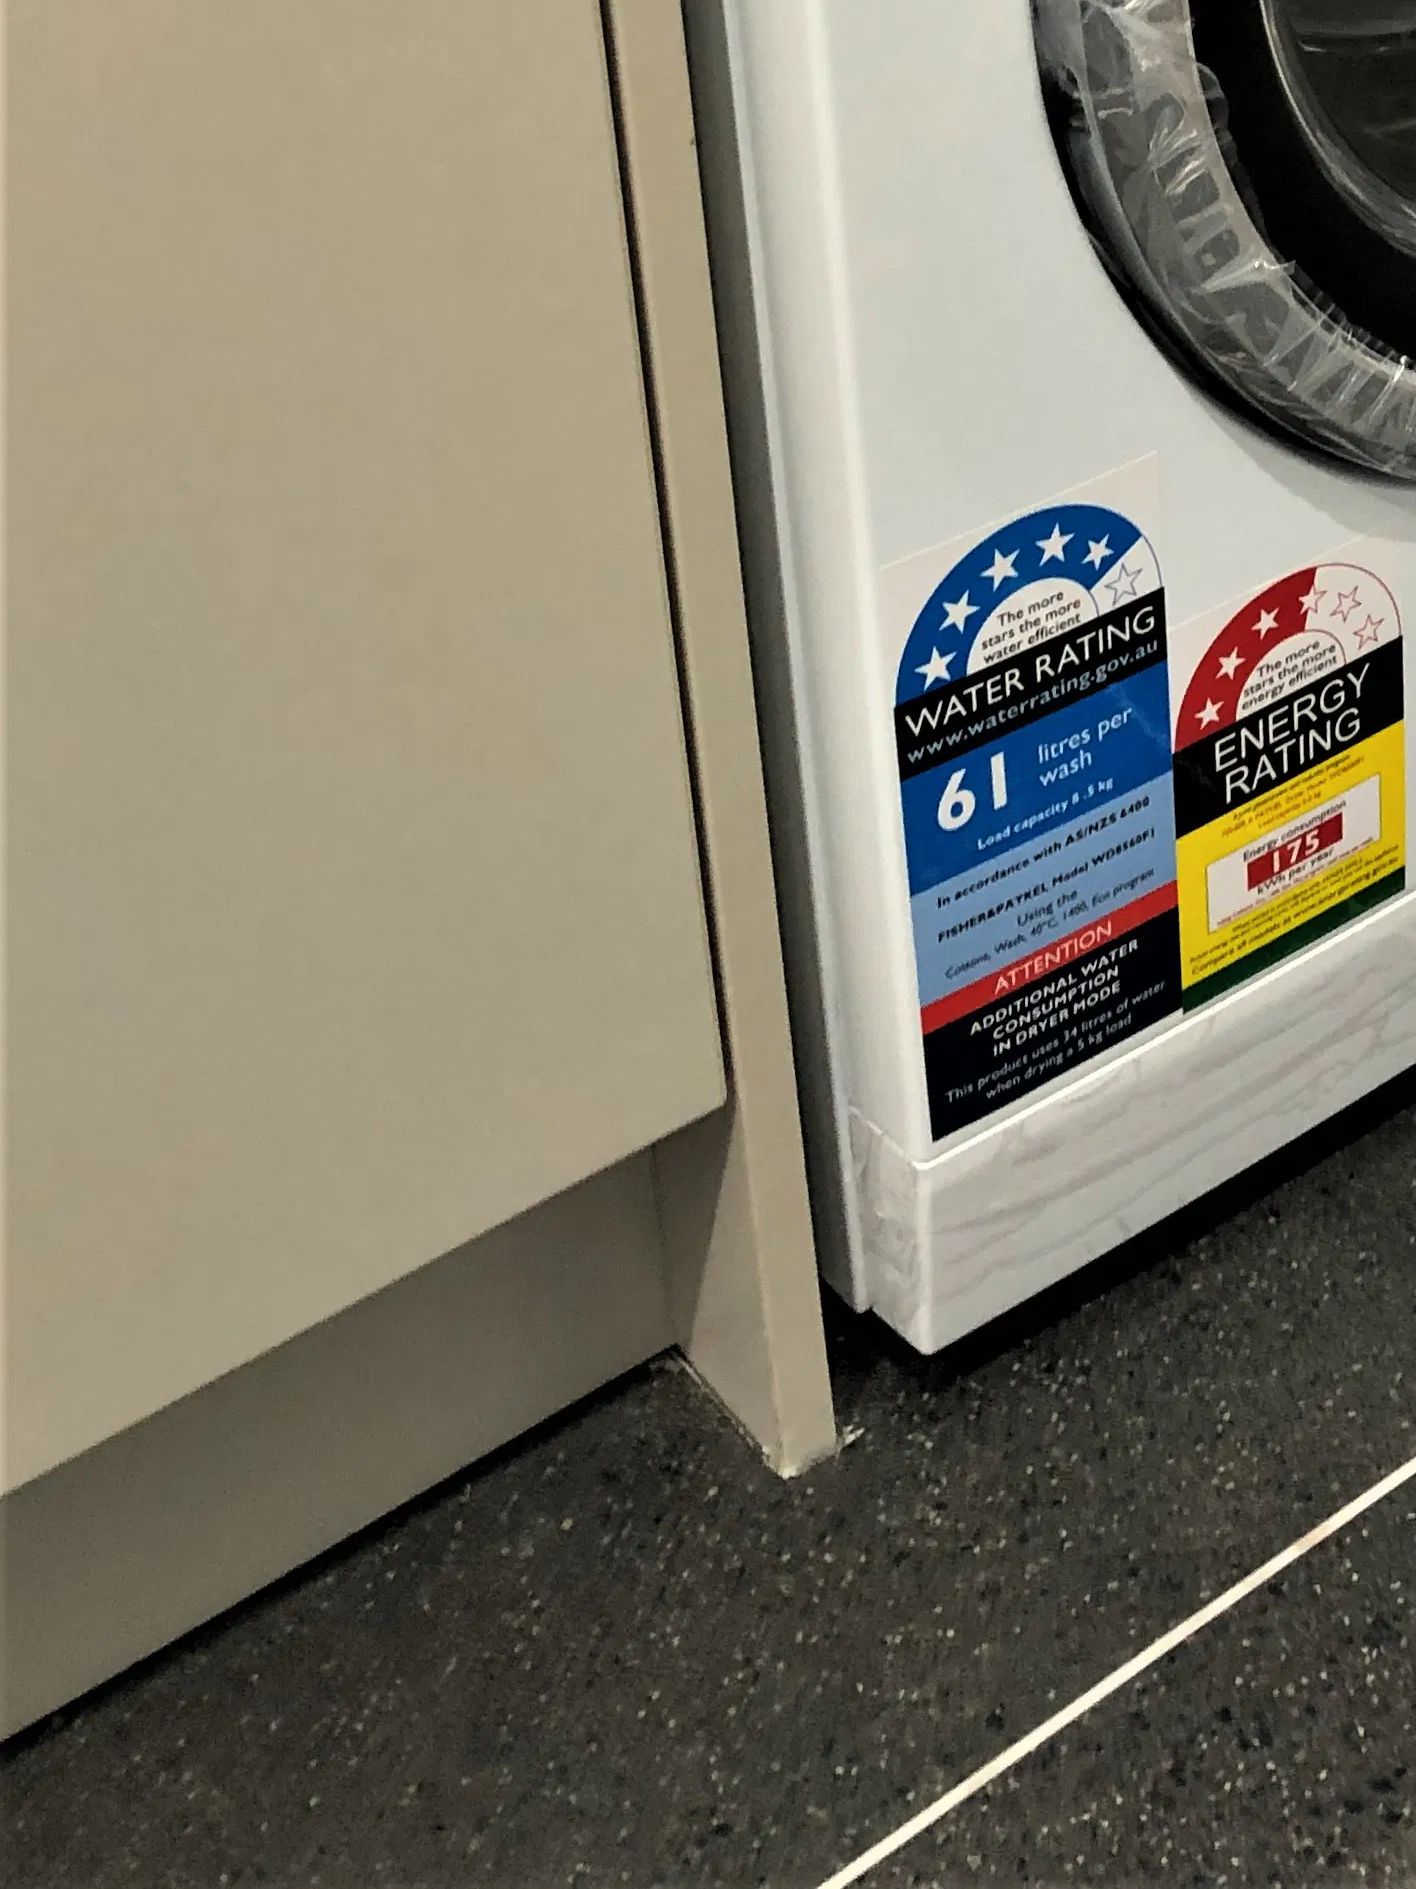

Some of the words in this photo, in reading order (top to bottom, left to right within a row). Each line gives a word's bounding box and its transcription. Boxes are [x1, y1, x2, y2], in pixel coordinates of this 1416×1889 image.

[981, 628, 1015, 651] stars
[1019, 617, 1042, 634] the
[1045, 598, 1081, 621] more
[983, 641, 1022, 664] water
[1027, 613, 1081, 645] efficient
[997, 607, 1024, 627] The
[1028, 591, 1064, 614] more
[905, 667, 1025, 737] WATER
[1035, 605, 1155, 684] RATING
[1241, 683, 1286, 710] energy
[1288, 655, 1338, 687] efficient
[1244, 677, 1275, 699] stars
[1277, 665, 1299, 680] the
[1302, 644, 1336, 667] more
[1257, 661, 1283, 678] The
[1285, 640, 1320, 663] more
[907, 640, 1158, 764] www.waterrating.gov.au
[1215, 662, 1370, 773] ENERGY
[1037, 728, 1092, 764] litres
[1097, 707, 1133, 742] per
[1039, 750, 1093, 787] wash
[1225, 707, 1361, 804] RATING
[937, 751, 1009, 832] 61
[977, 826, 1011, 850] Load
[1013, 799, 1069, 833] capacity
[1098, 778, 1114, 793] kg
[937, 897, 951, 909] In
[954, 859, 1030, 901] accordance
[1033, 842, 1061, 862] with
[1065, 811, 1117, 847] AS/NZS
[1119, 796, 1150, 818] 6400
[1243, 837, 1279, 861] Energy
[1281, 800, 1347, 839] consumption
[1272, 828, 1320, 874] 175
[1052, 863, 1089, 887] Model
[1257, 874, 1286, 895] kWh
[1288, 864, 1308, 881] per
[1311, 849, 1335, 868] year
[1017, 902, 1054, 927] Using
[1057, 890, 1078, 907] the
[970, 972, 1077, 1036] ADDITIONAL
[1081, 939, 1138, 977] WATER
[994, 920, 1112, 995] ATTENTION
[993, 965, 1119, 1039] CONSUMPTION
[993, 1040, 1011, 1057] IN
[1016, 1006, 1069, 1045] DRYER
[1073, 979, 1121, 1015] MODE
[945, 1082, 974, 1103] This
[977, 1054, 1028, 1092] product
[1116, 998, 1129, 1014] of
[1132, 980, 1167, 1005] water
[986, 1075, 1021, 1100] when
[1024, 1050, 1064, 1080] drying
[1106, 1013, 1132, 1036] load
